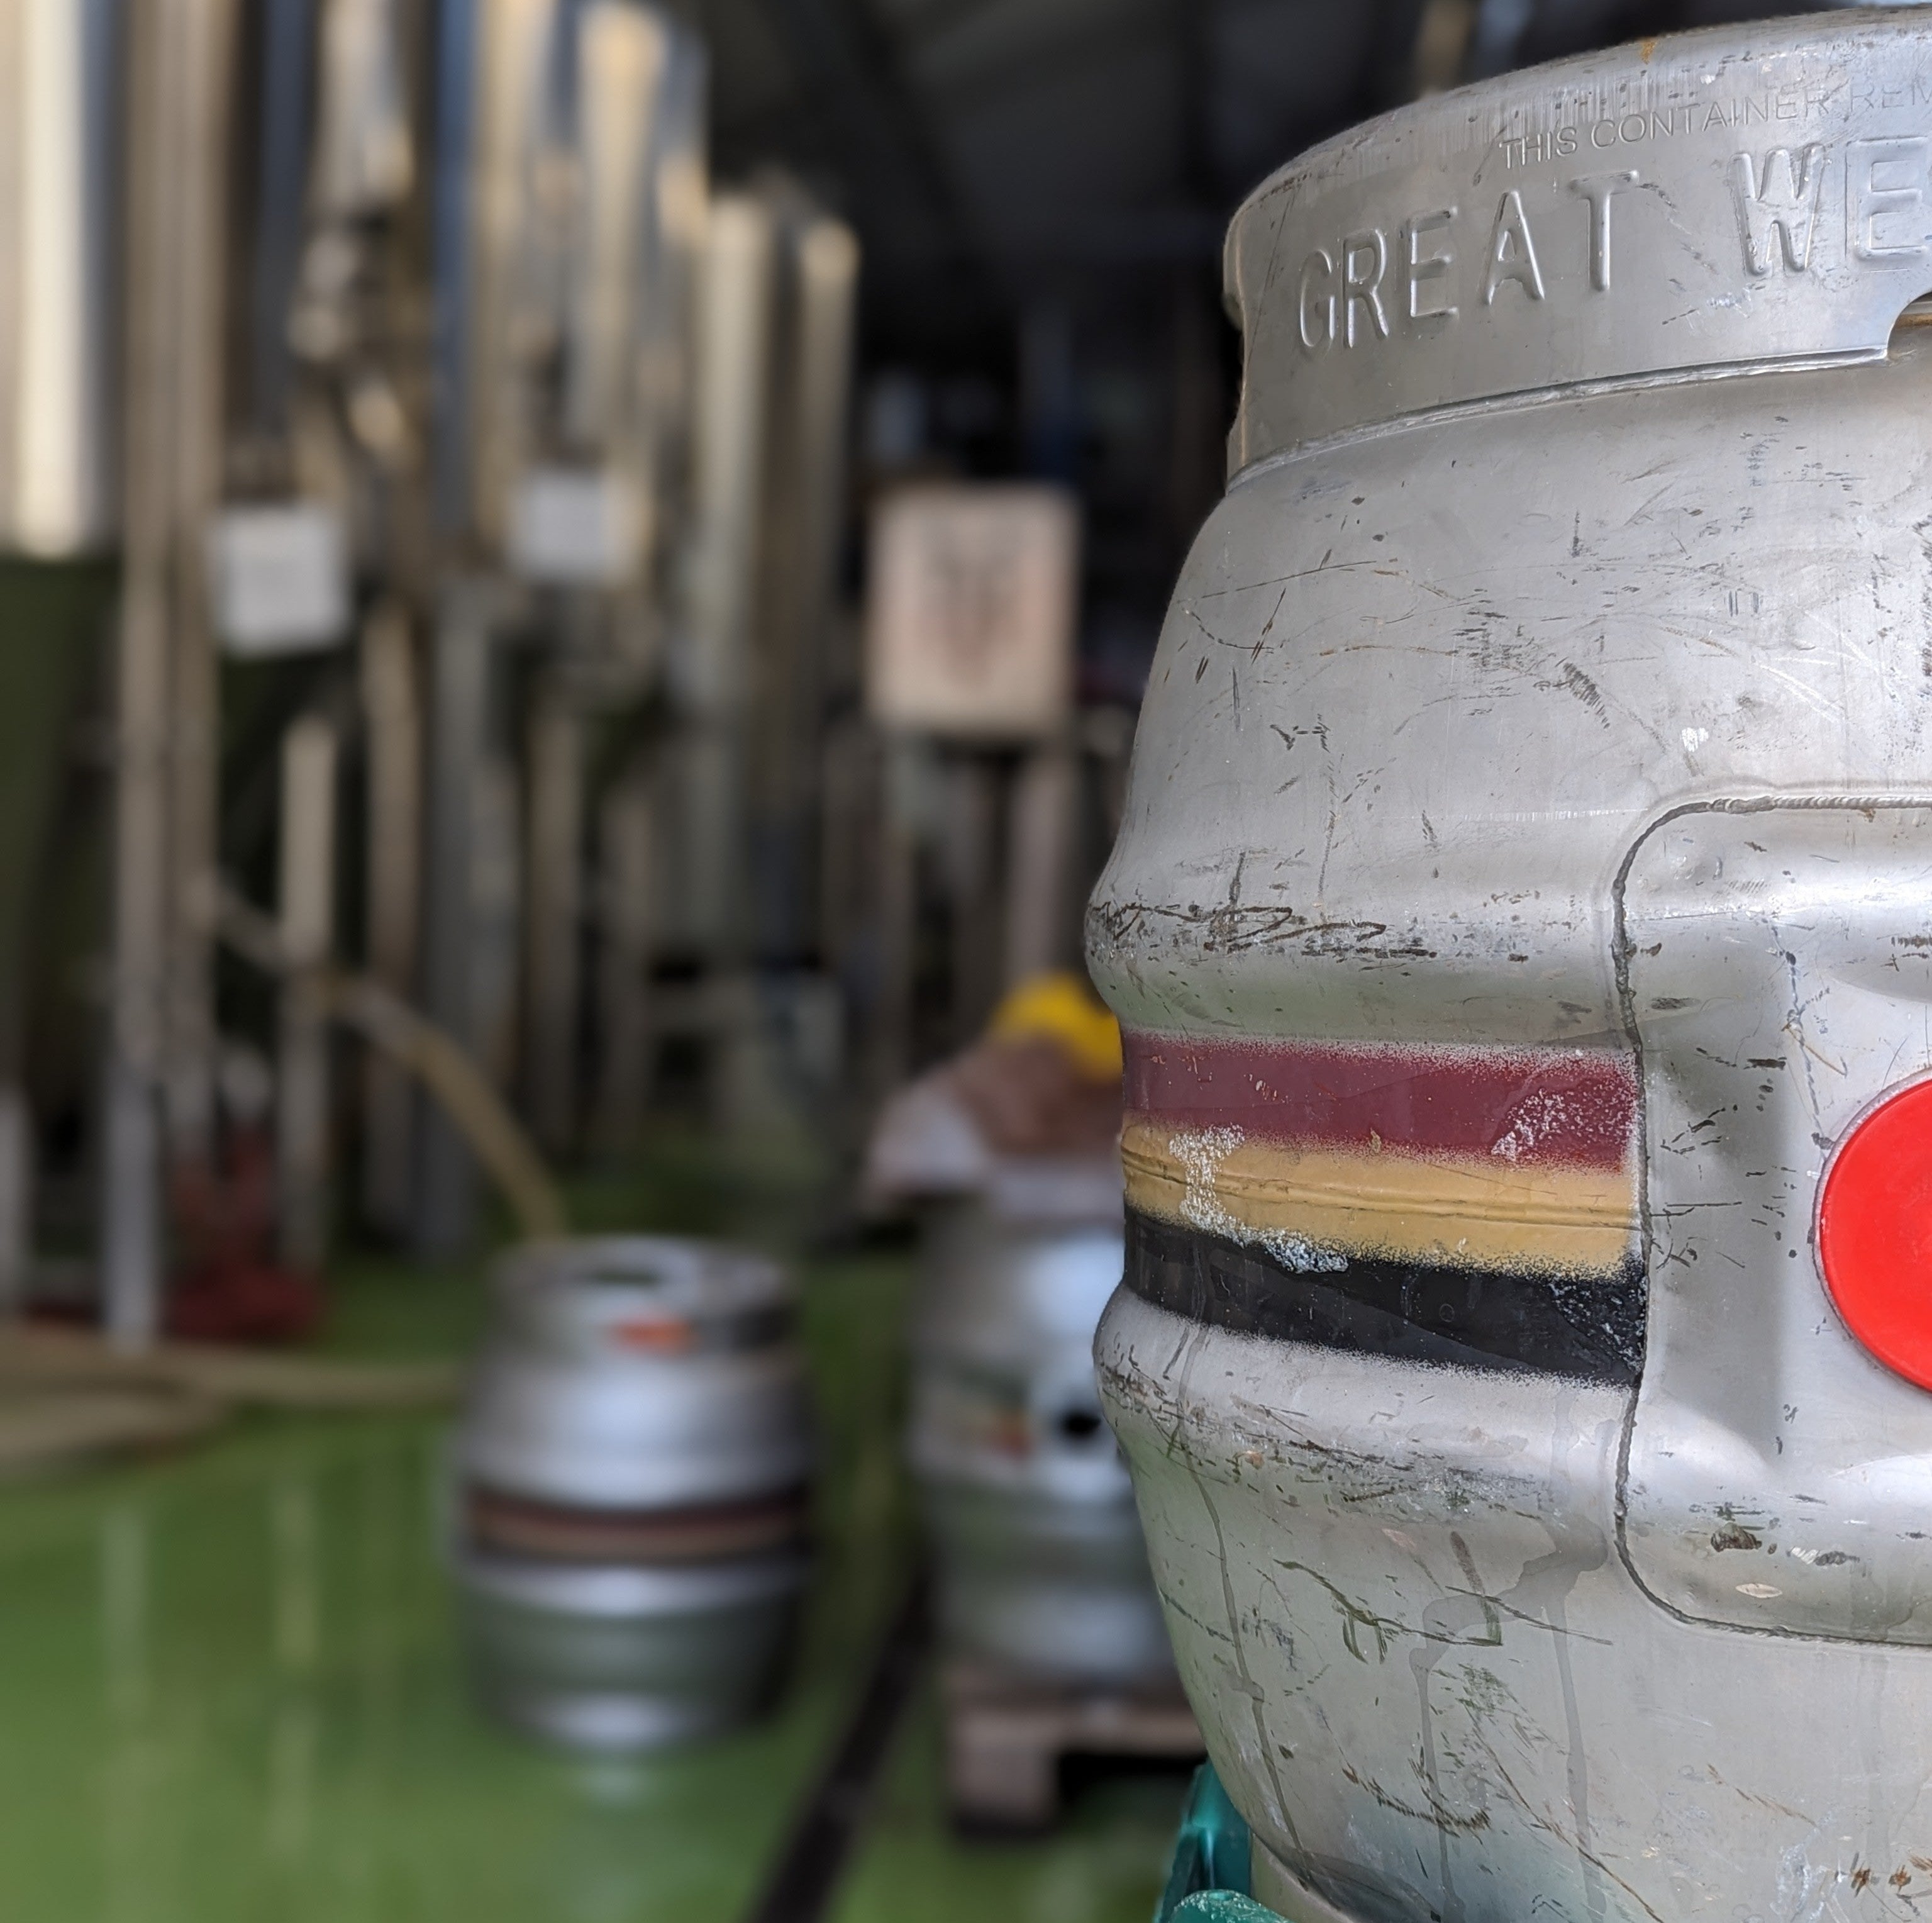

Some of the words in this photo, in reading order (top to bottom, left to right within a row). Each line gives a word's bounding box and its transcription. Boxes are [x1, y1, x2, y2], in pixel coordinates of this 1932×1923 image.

[1499, 126, 1577, 169] THIS
[1591, 84, 1829, 150] CONTAINER
[1298, 169, 1639, 352] GREAT
[1727, 135, 1930, 276] WE
